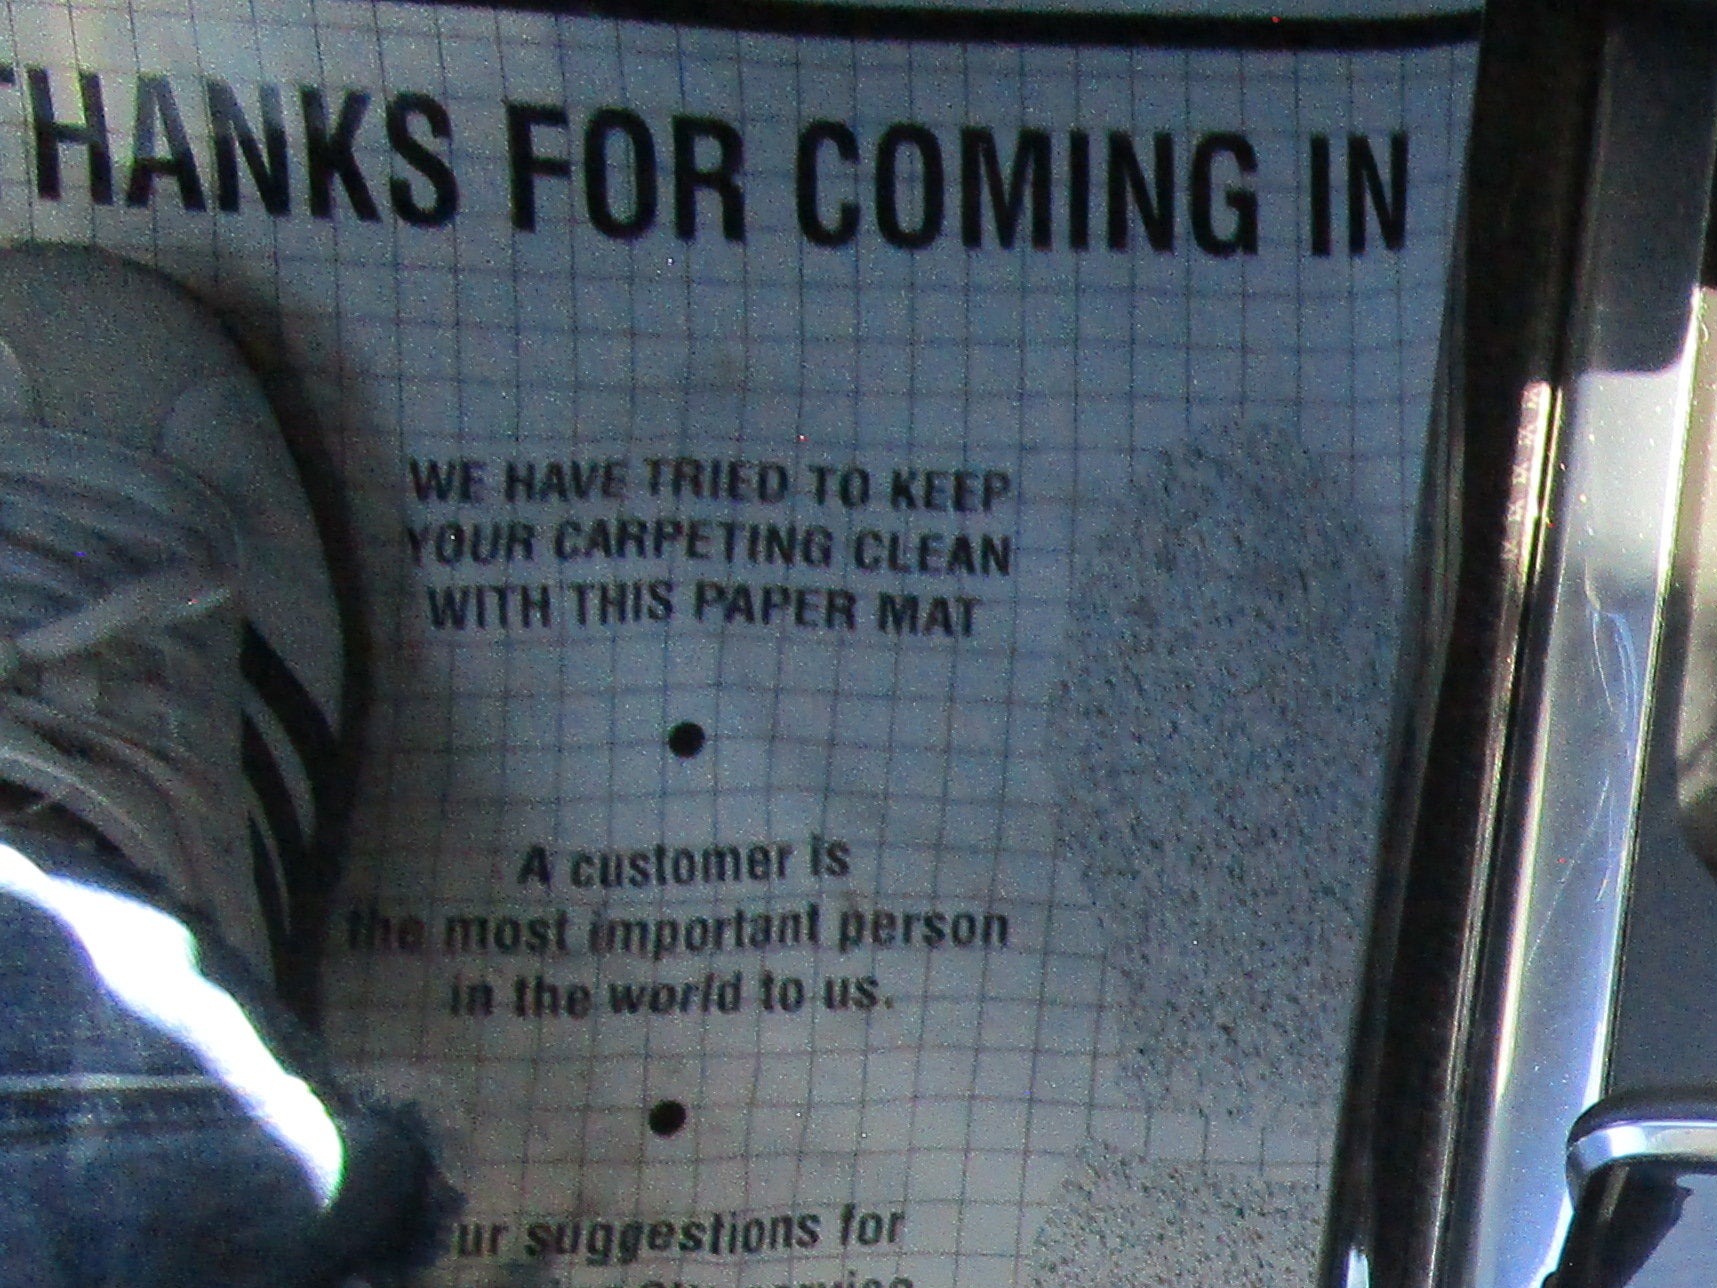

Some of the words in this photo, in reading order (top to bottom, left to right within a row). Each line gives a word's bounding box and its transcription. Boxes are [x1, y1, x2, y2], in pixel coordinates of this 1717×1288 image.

[0, 62, 459, 229] HANKS
[508, 100, 747, 248] FOR
[799, 119, 1262, 257] COMING
[1308, 129, 1411, 258] IN
[409, 457, 485, 502] WE
[505, 459, 627, 502] HAVE
[645, 457, 789, 504] TRIED
[809, 464, 870, 511] TO
[891, 468, 1011, 514] KEEP
[406, 521, 535, 567] YOUR
[554, 517, 833, 569] CARPETING
[853, 528, 1011, 577] CLEAN
[427, 584, 551, 631] WITH
[568, 580, 674, 626] THIS
[695, 580, 858, 632] PAPER
[878, 590, 984, 638] MAT
[517, 844, 552, 889] A
[569, 842, 792, 889] customer
[446, 909, 568, 953] most
[588, 902, 819, 962] important
[841, 909, 1009, 955] person
[515, 974, 592, 1019] the
[608, 969, 744, 1017] world
[759, 969, 804, 1013] to
[525, 1209, 821, 1267] suggestions
[840, 1202, 906, 1247] for
